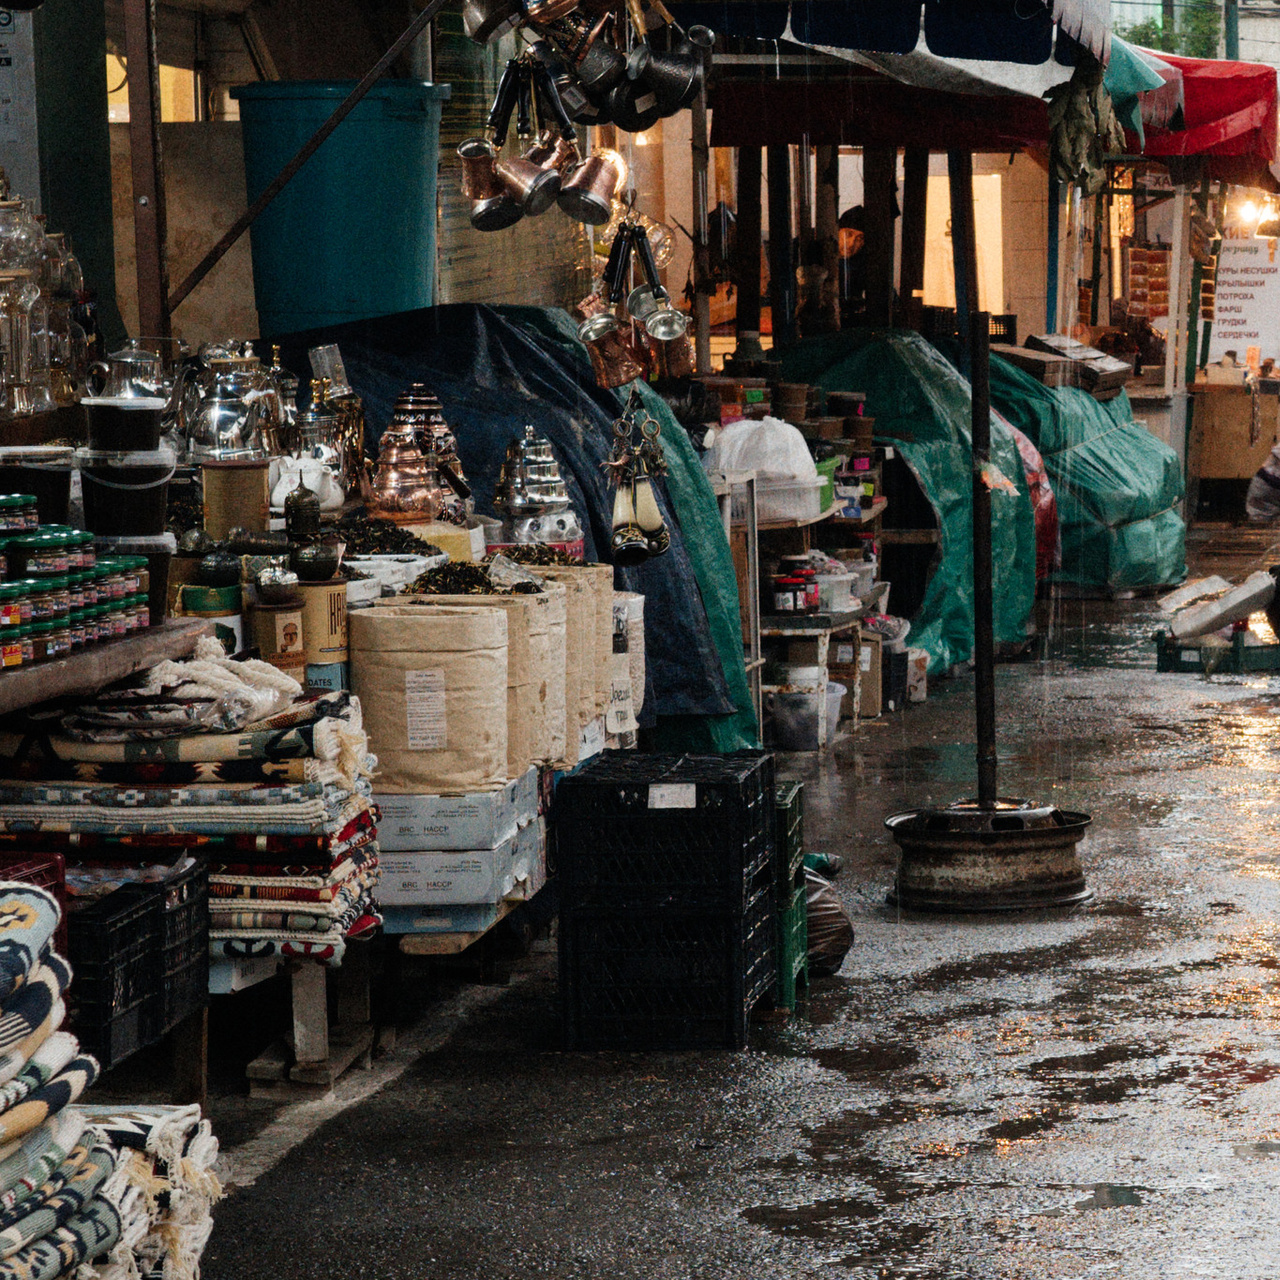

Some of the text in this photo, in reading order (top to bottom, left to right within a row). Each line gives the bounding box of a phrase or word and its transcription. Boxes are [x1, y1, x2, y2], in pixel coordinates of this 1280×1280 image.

[1240, 267, 1278, 275] НЕСУШКИ
[1217, 292, 1255, 300] ПОТРОХА
[1217, 305, 1243, 313] ФАРШ
[1217, 318, 1247, 326] ГРУДКИ
[1217, 331, 1259, 339] СЕРДЕЧКИ
[423, 825, 450, 833] HACCP
[427, 881, 453, 889] HACCP
